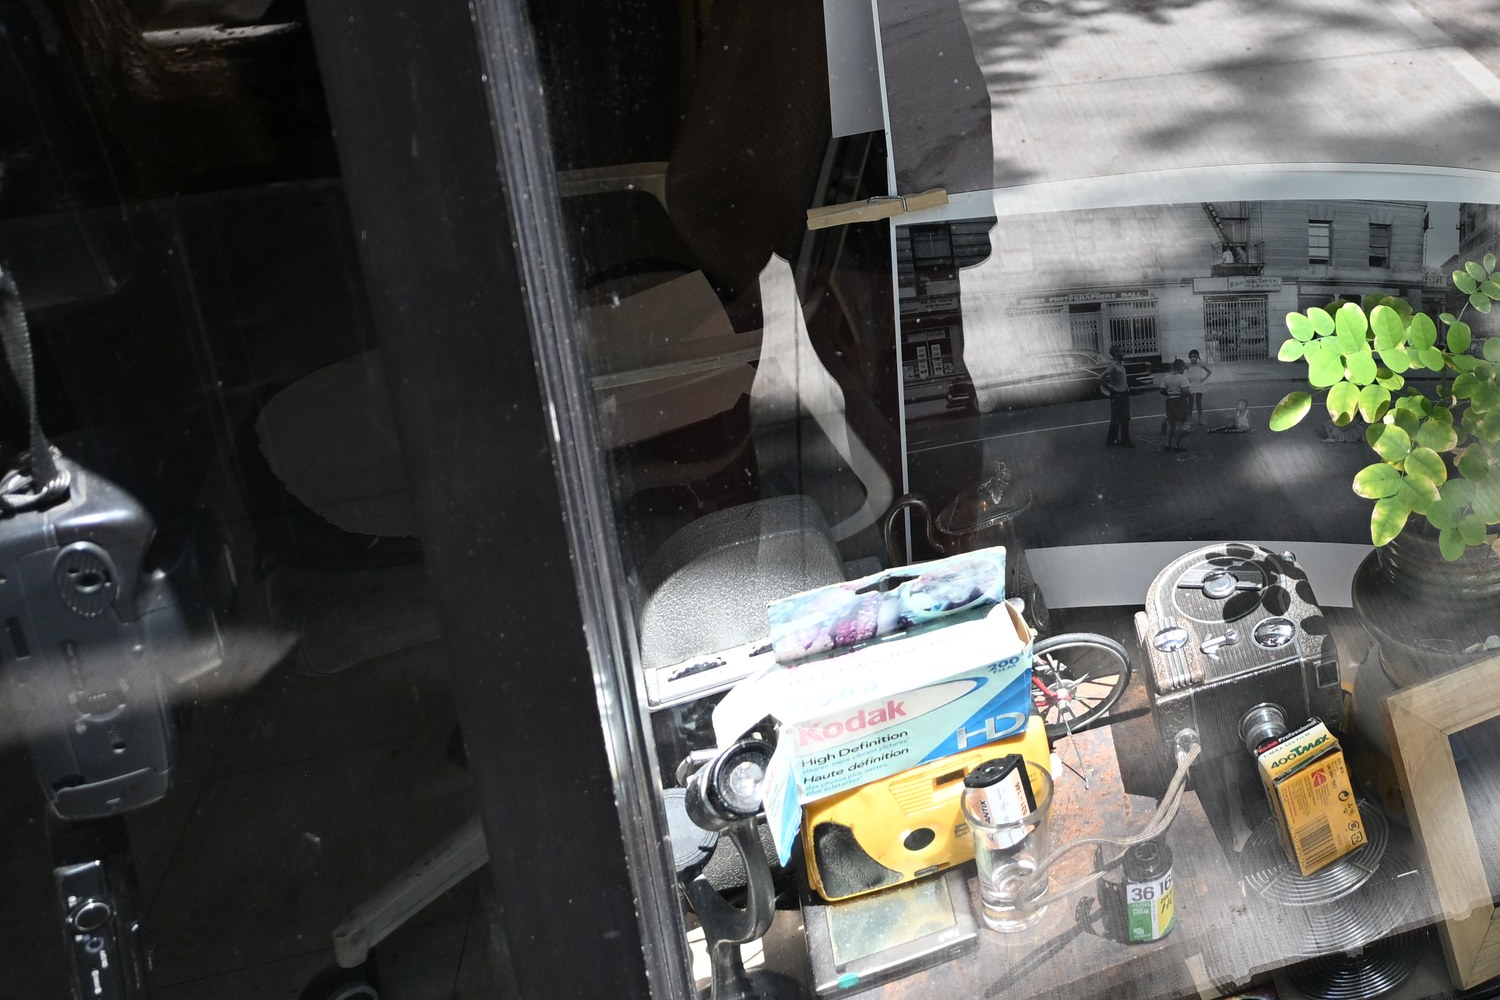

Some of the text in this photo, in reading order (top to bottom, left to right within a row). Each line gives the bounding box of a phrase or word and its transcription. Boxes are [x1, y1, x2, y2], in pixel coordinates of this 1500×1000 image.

[987, 655, 1020, 672] 200
[993, 664, 1016, 674] FILM
[799, 699, 907, 747] Kodak
[957, 712, 1027, 750] HD
[1278, 720, 1317, 743] Professional
[801, 730, 909, 768] High Definition
[803, 747, 909, 785] Haute définition
[1131, 886, 1155, 902] 36
